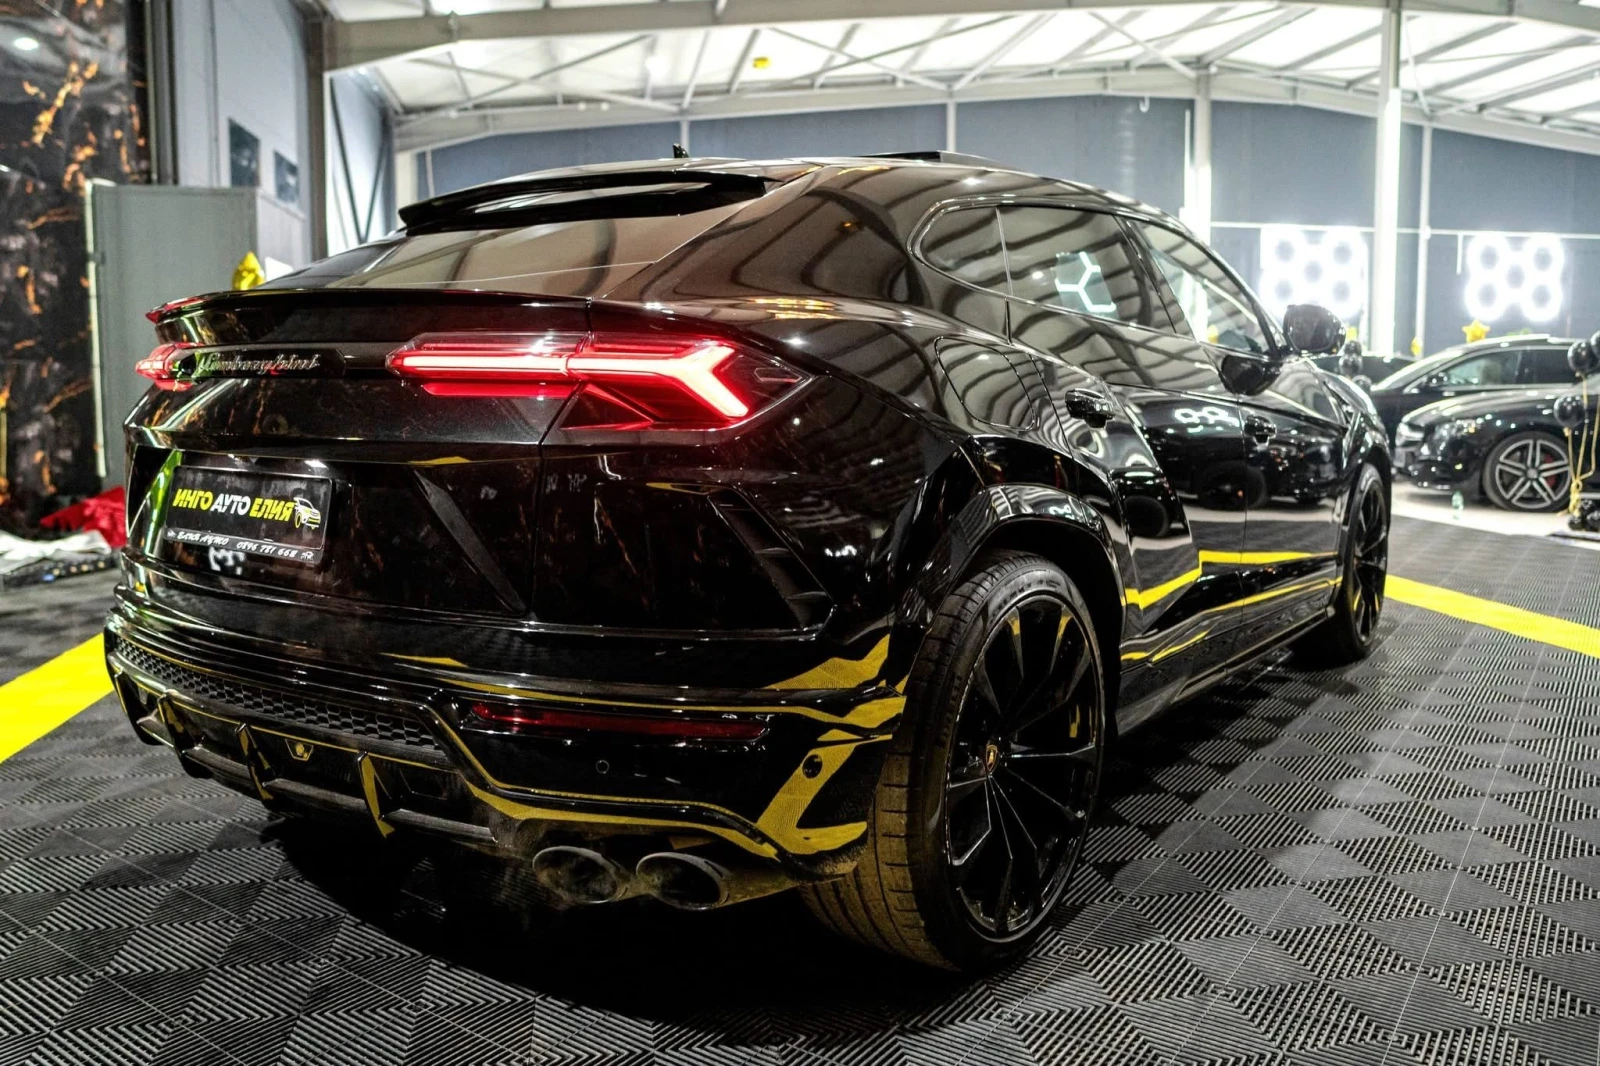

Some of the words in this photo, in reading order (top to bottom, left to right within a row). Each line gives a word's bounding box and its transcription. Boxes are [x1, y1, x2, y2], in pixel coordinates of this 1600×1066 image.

[199, 352, 320, 374] Lamborghini
[172, 488, 213, 511] ИНГО
[210, 493, 251, 515] АУТО
[249, 498, 296, 522] ЕЛИЯ
[236, 541, 259, 551] 0896
[259, 544, 277, 555] 781
